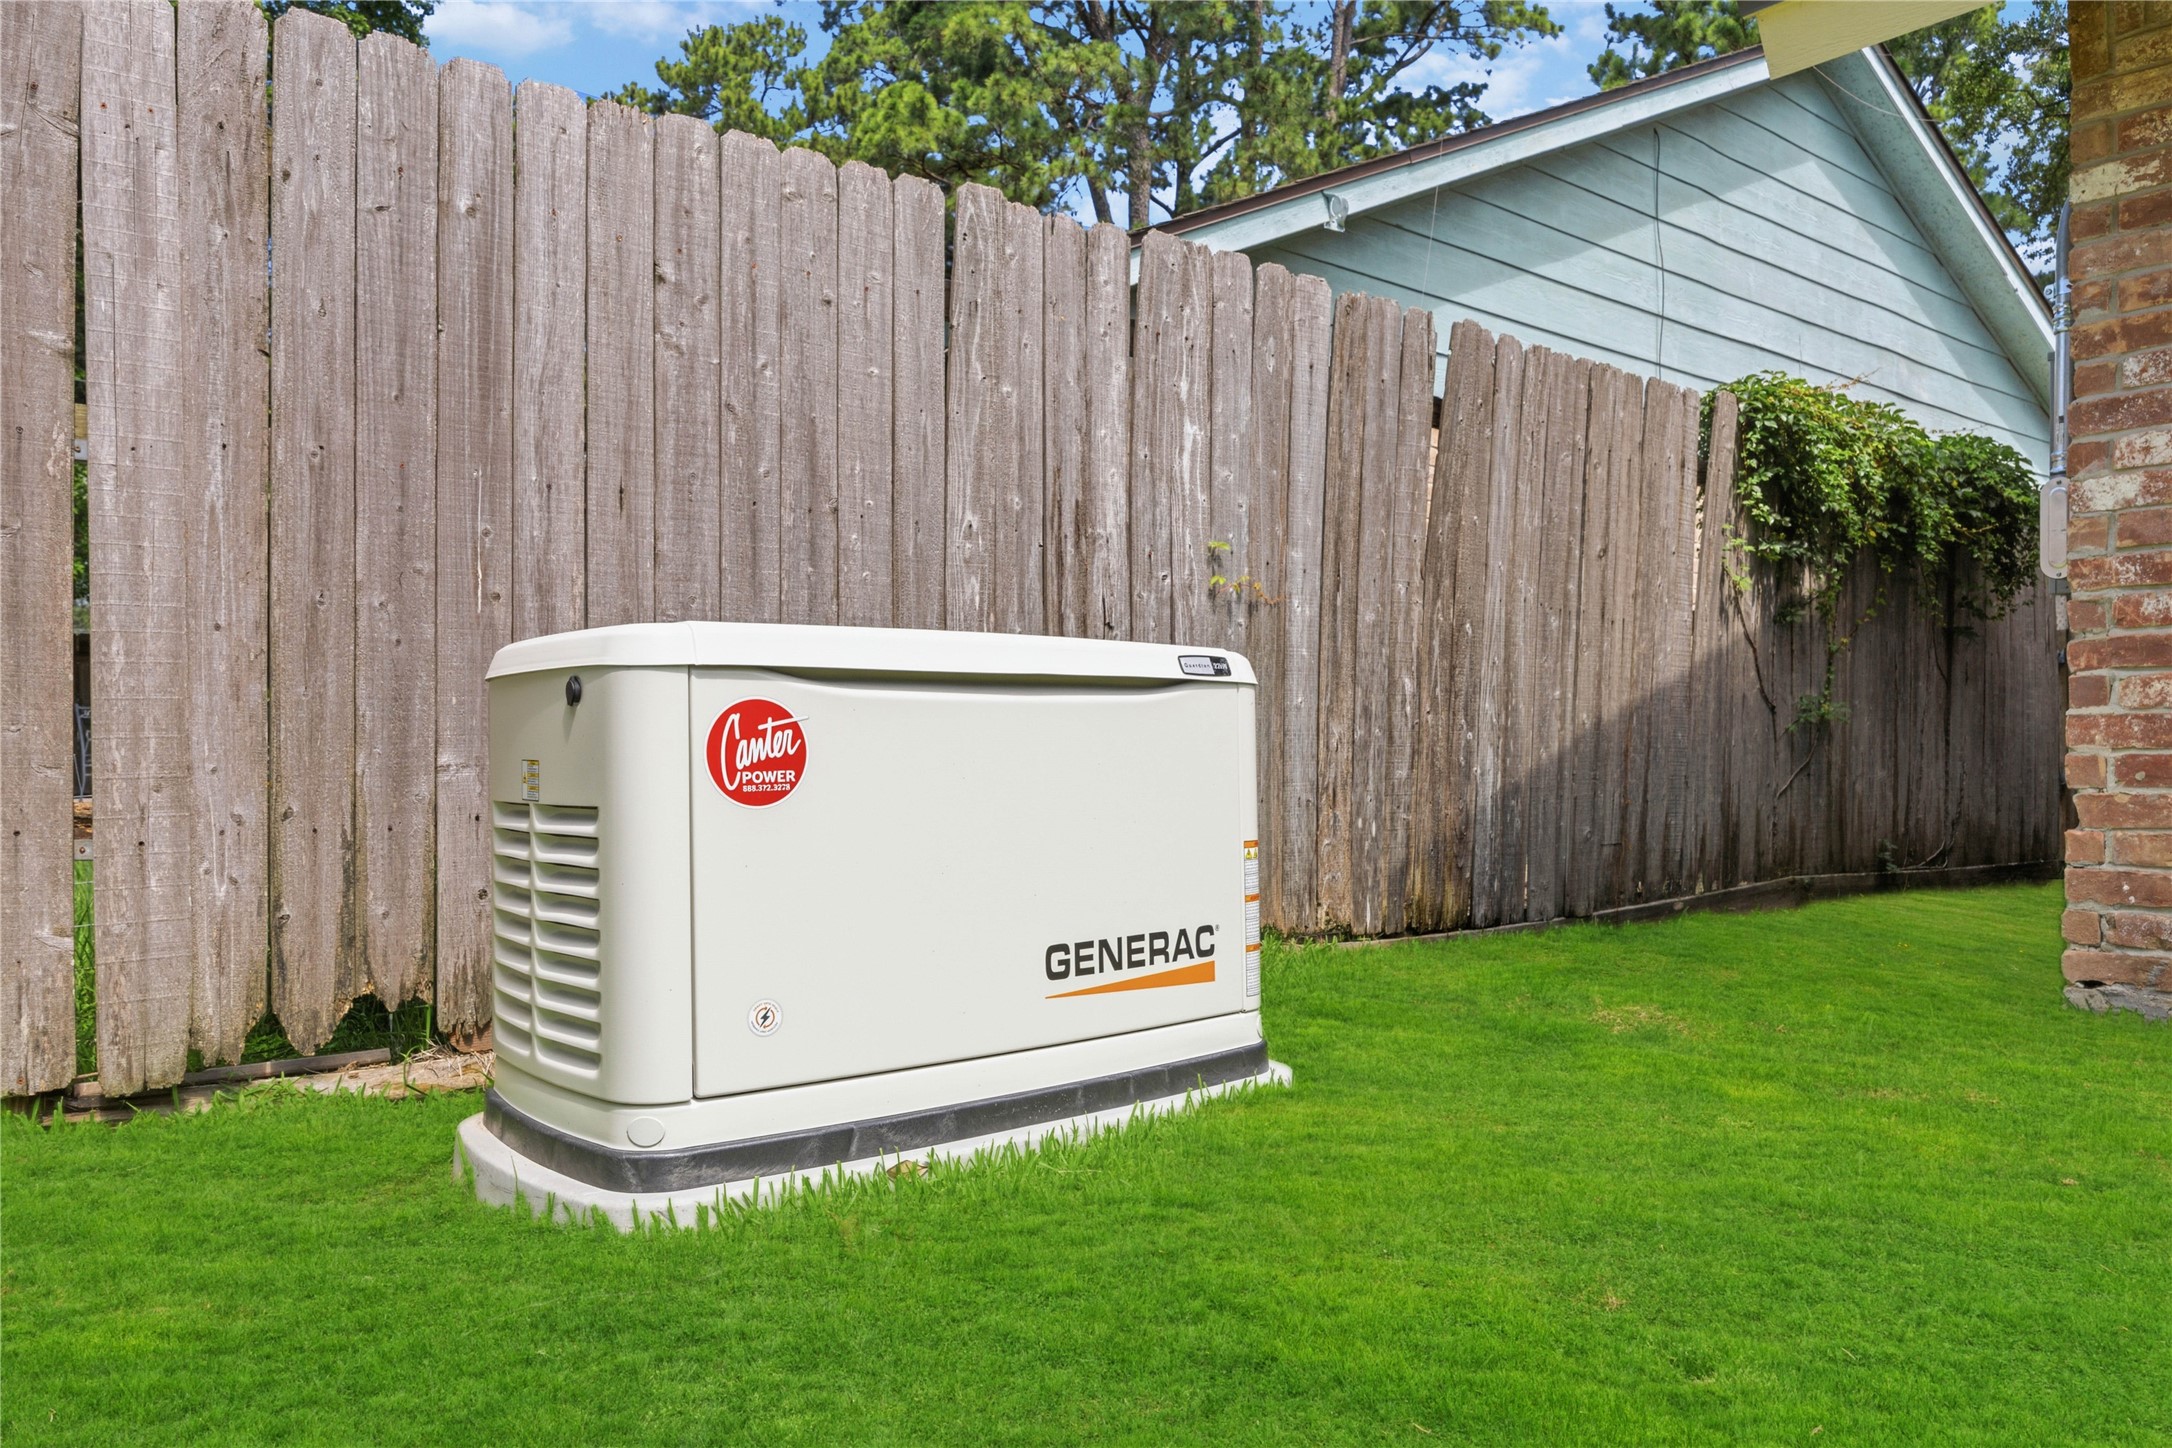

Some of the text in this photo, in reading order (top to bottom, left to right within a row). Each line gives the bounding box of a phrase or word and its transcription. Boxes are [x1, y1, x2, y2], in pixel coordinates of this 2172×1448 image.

[721, 713, 809, 790] Canter
[742, 770, 796, 784] POWER
[1045, 924, 1216, 981] GENERAC
